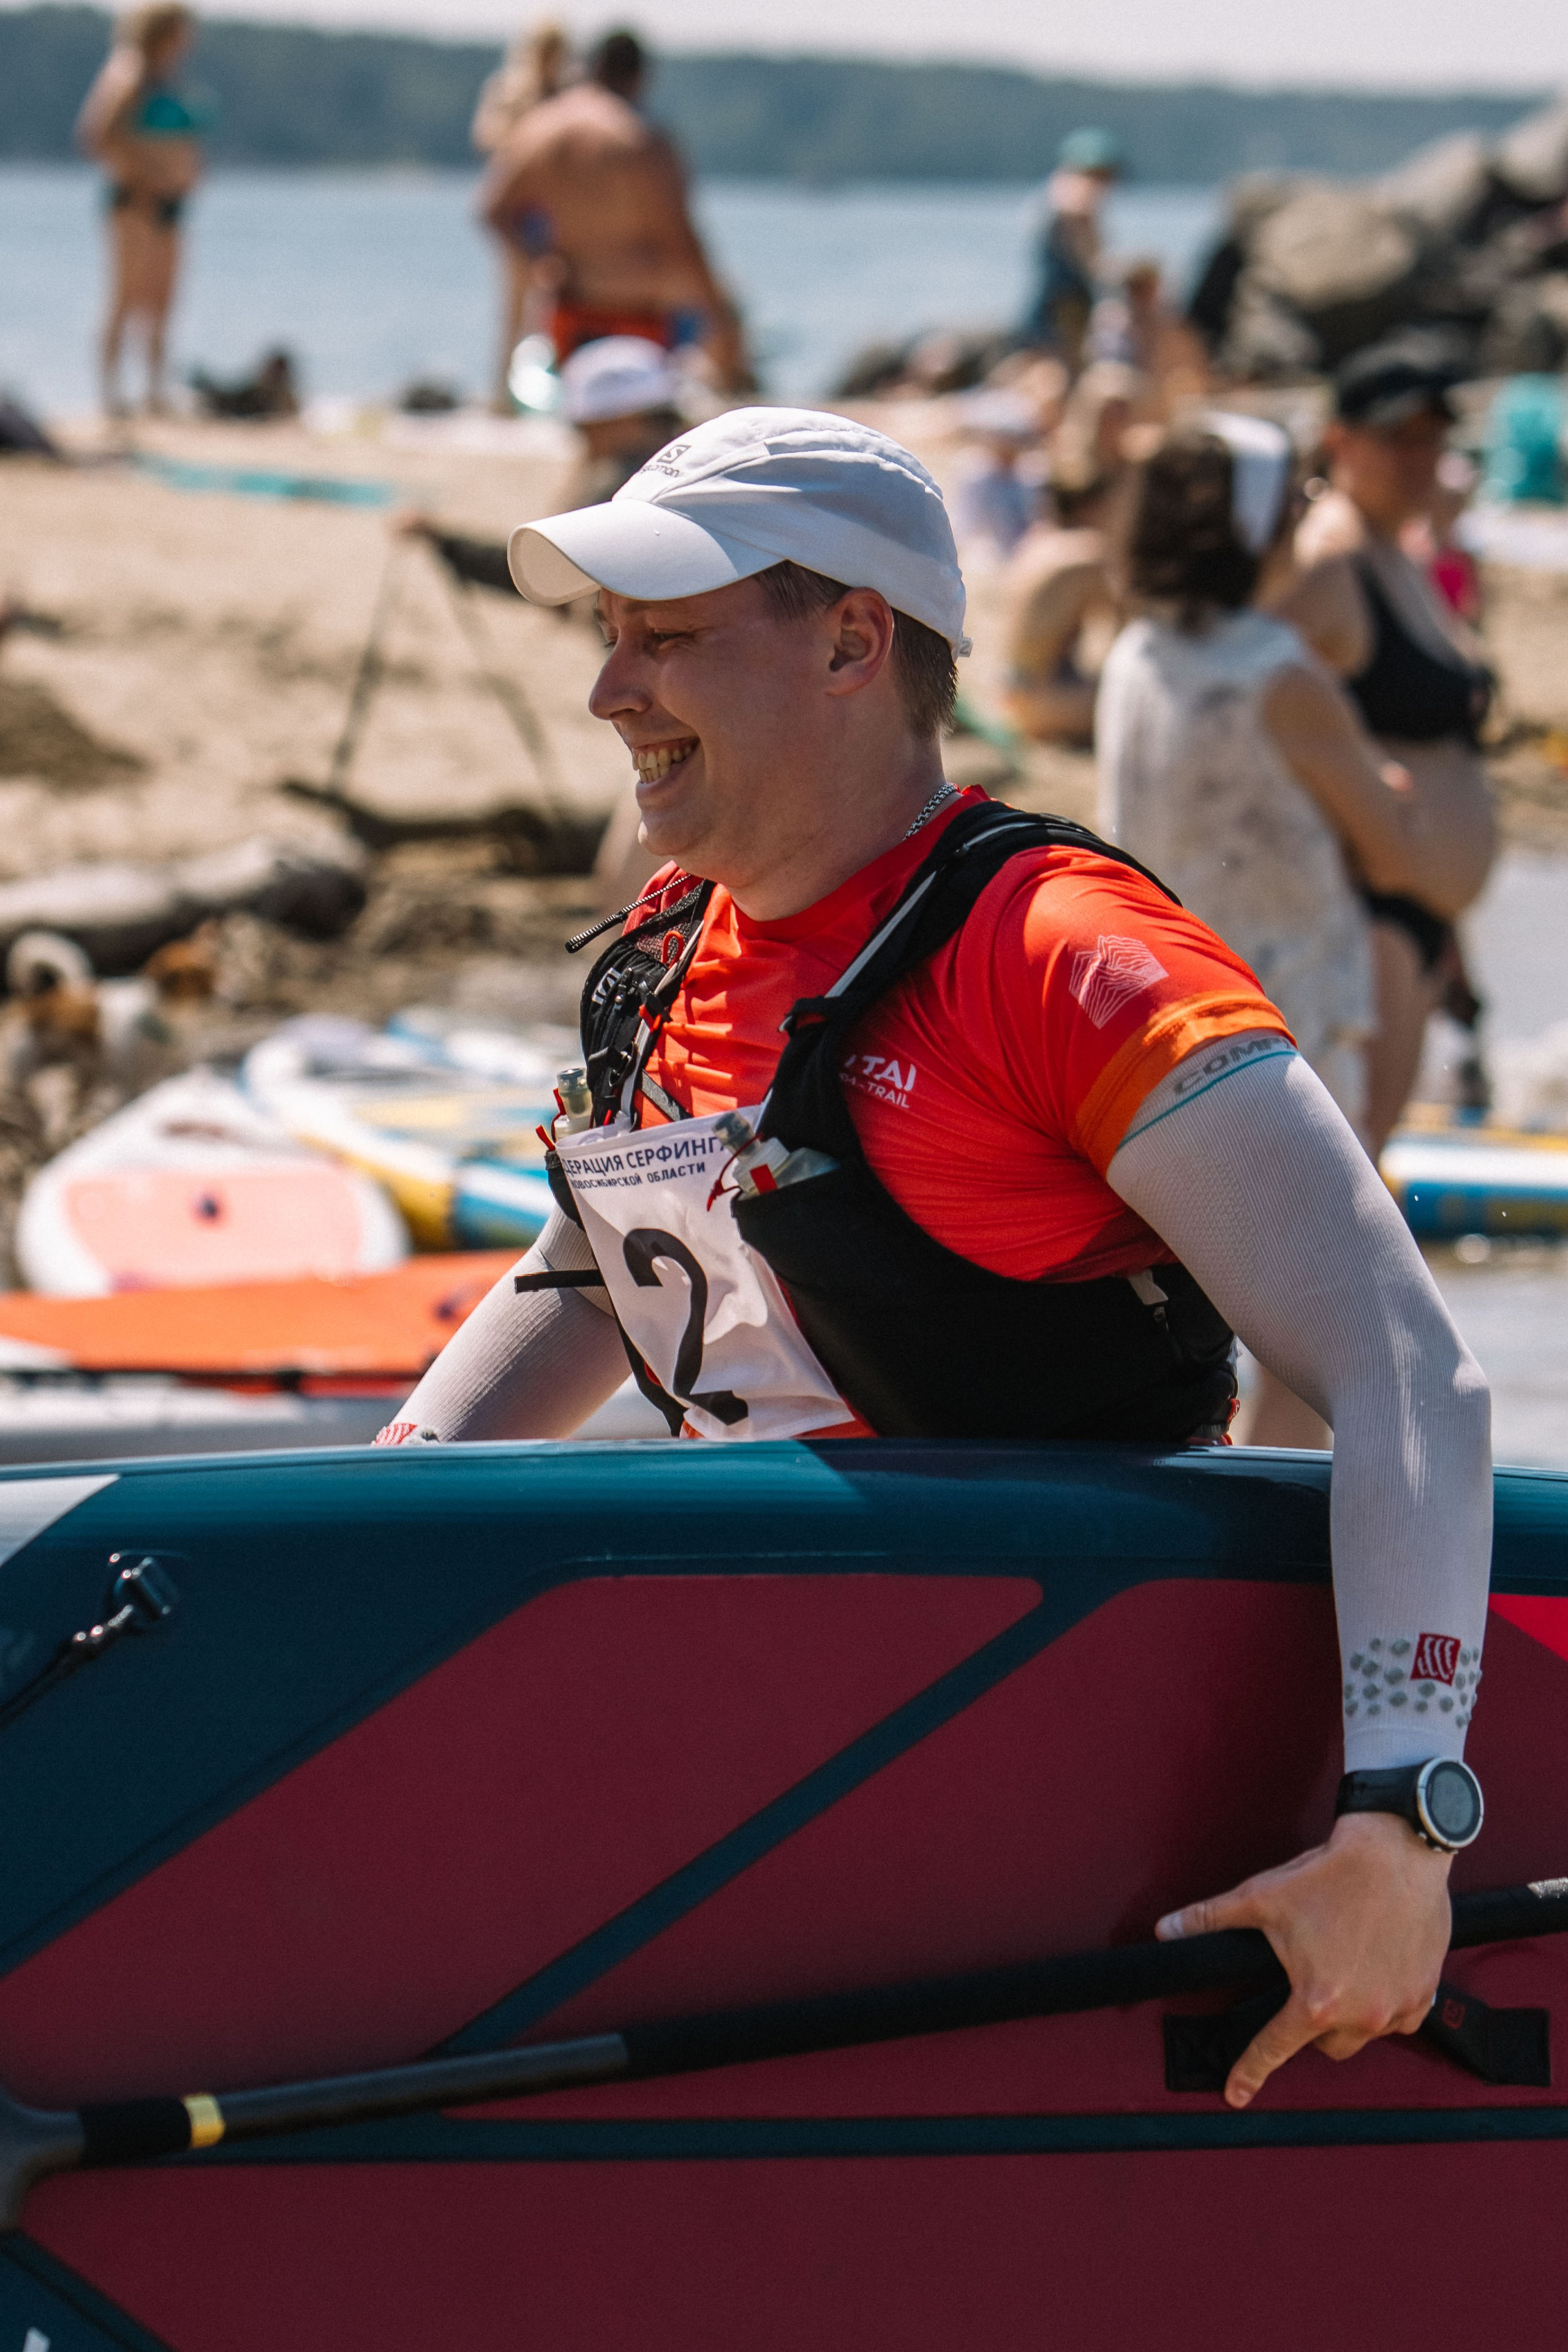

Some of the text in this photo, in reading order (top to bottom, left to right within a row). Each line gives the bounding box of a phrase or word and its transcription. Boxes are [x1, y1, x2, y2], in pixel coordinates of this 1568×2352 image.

[626, 1137, 724, 1169] СЕРФИНГ
[647, 1162, 705, 1183] ОБЛАСТИ
[622, 1228, 749, 1427] 2
